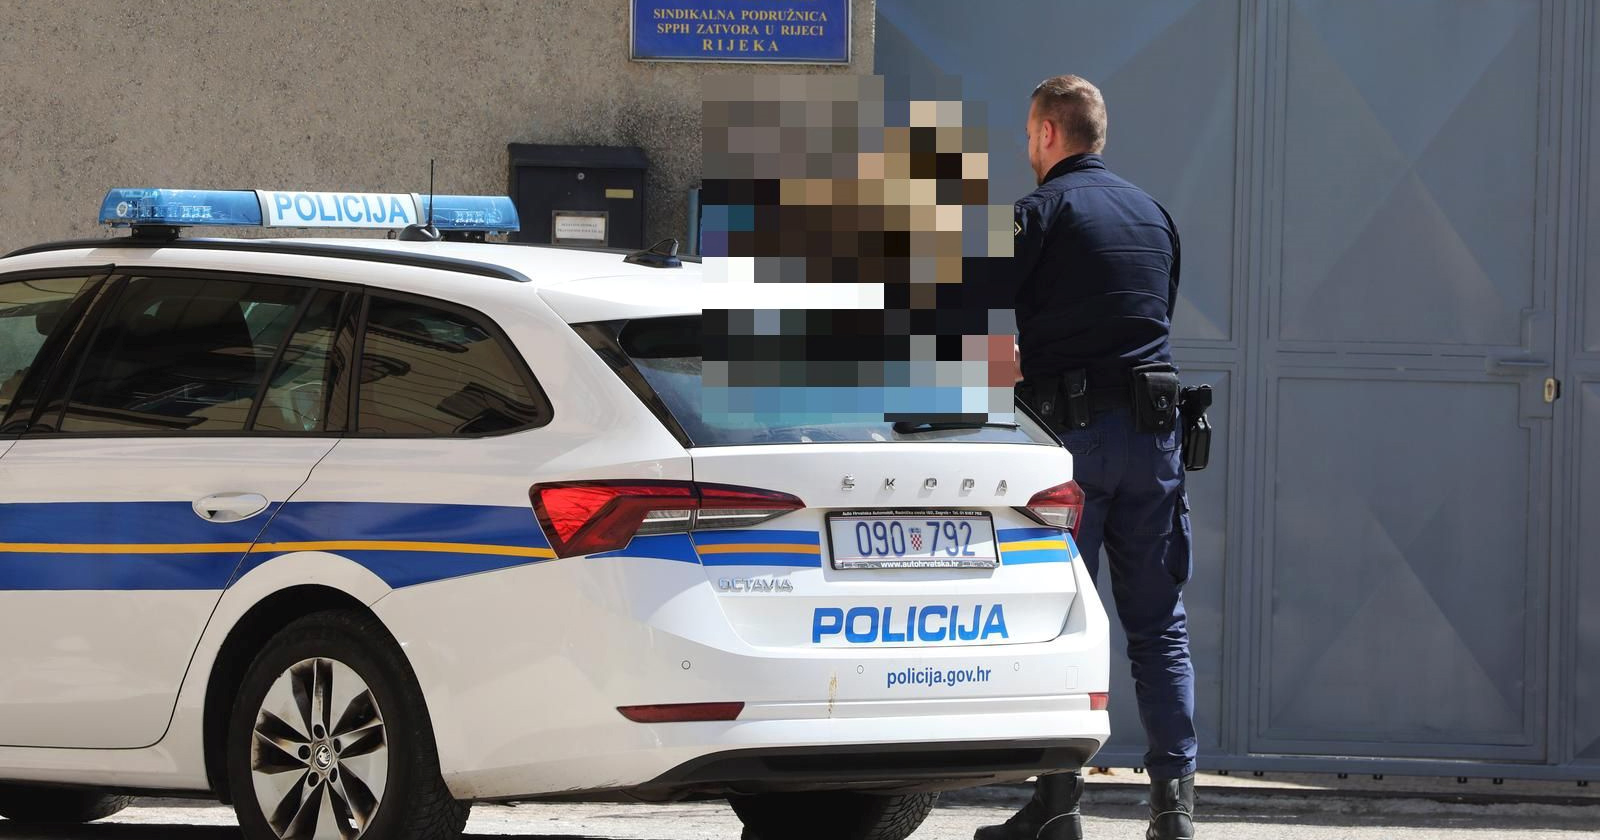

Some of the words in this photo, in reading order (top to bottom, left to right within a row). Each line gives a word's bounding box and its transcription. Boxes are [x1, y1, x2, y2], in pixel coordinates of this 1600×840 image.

[653, 8, 735, 20] SINDIKALNA
[741, 8, 828, 22] PODRUŽNICA
[656, 23, 690, 34] SPPH
[696, 24, 760, 35] ZATVORA
[765, 24, 774, 35] U
[780, 25, 824, 36] RIJECI
[702, 39, 779, 52] RIJEKA
[275, 191, 409, 224] POLICIJA
[855, 521, 906, 557] 090
[926, 521, 976, 557] 792
[880, 560, 960, 569] www.autohrvatska.hr
[718, 577, 793, 592] OCTAVIA
[812, 603, 1009, 644] POLICIJA
[887, 665, 992, 688] policija.gov.hr
